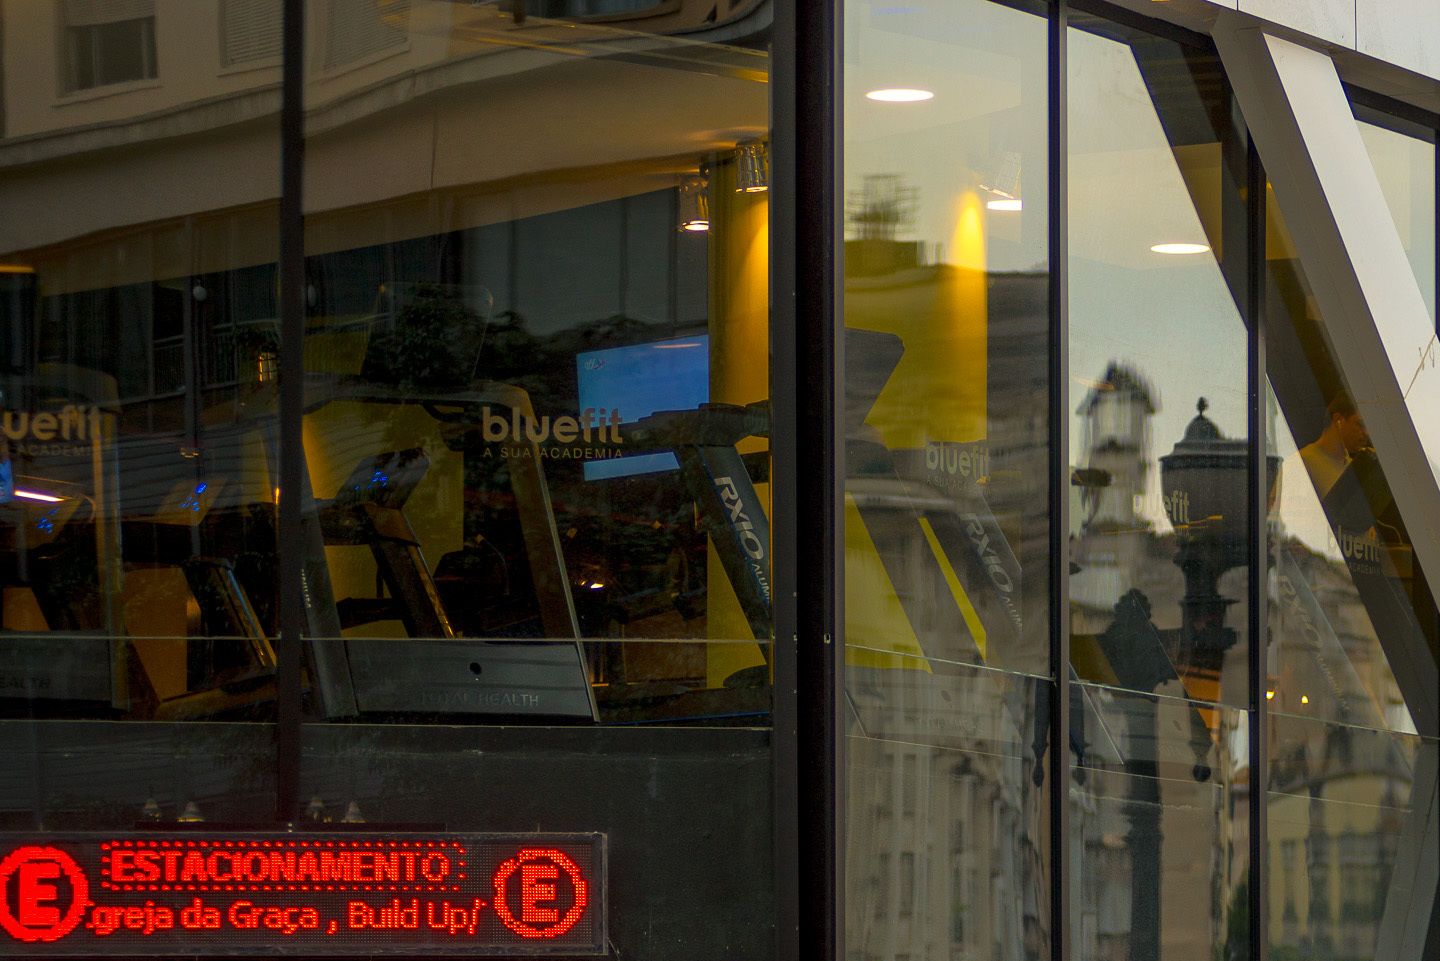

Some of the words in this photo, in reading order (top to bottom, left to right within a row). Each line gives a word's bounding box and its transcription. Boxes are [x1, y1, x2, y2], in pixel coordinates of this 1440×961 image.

[482, 406, 625, 444] bluefit
[483, 447, 493, 459] A
[500, 447, 532, 459] SUA
[539, 447, 623, 459] ACADEMIA
[925, 442, 990, 479] bluefit
[110, 850, 451, 882] ESTACIONAMENTO
[20, 863, 61, 925] E
[522, 864, 559, 922] E
[180, 898, 221, 930] da
[229, 900, 320, 936] Graça
[349, 898, 420, 930] Build
